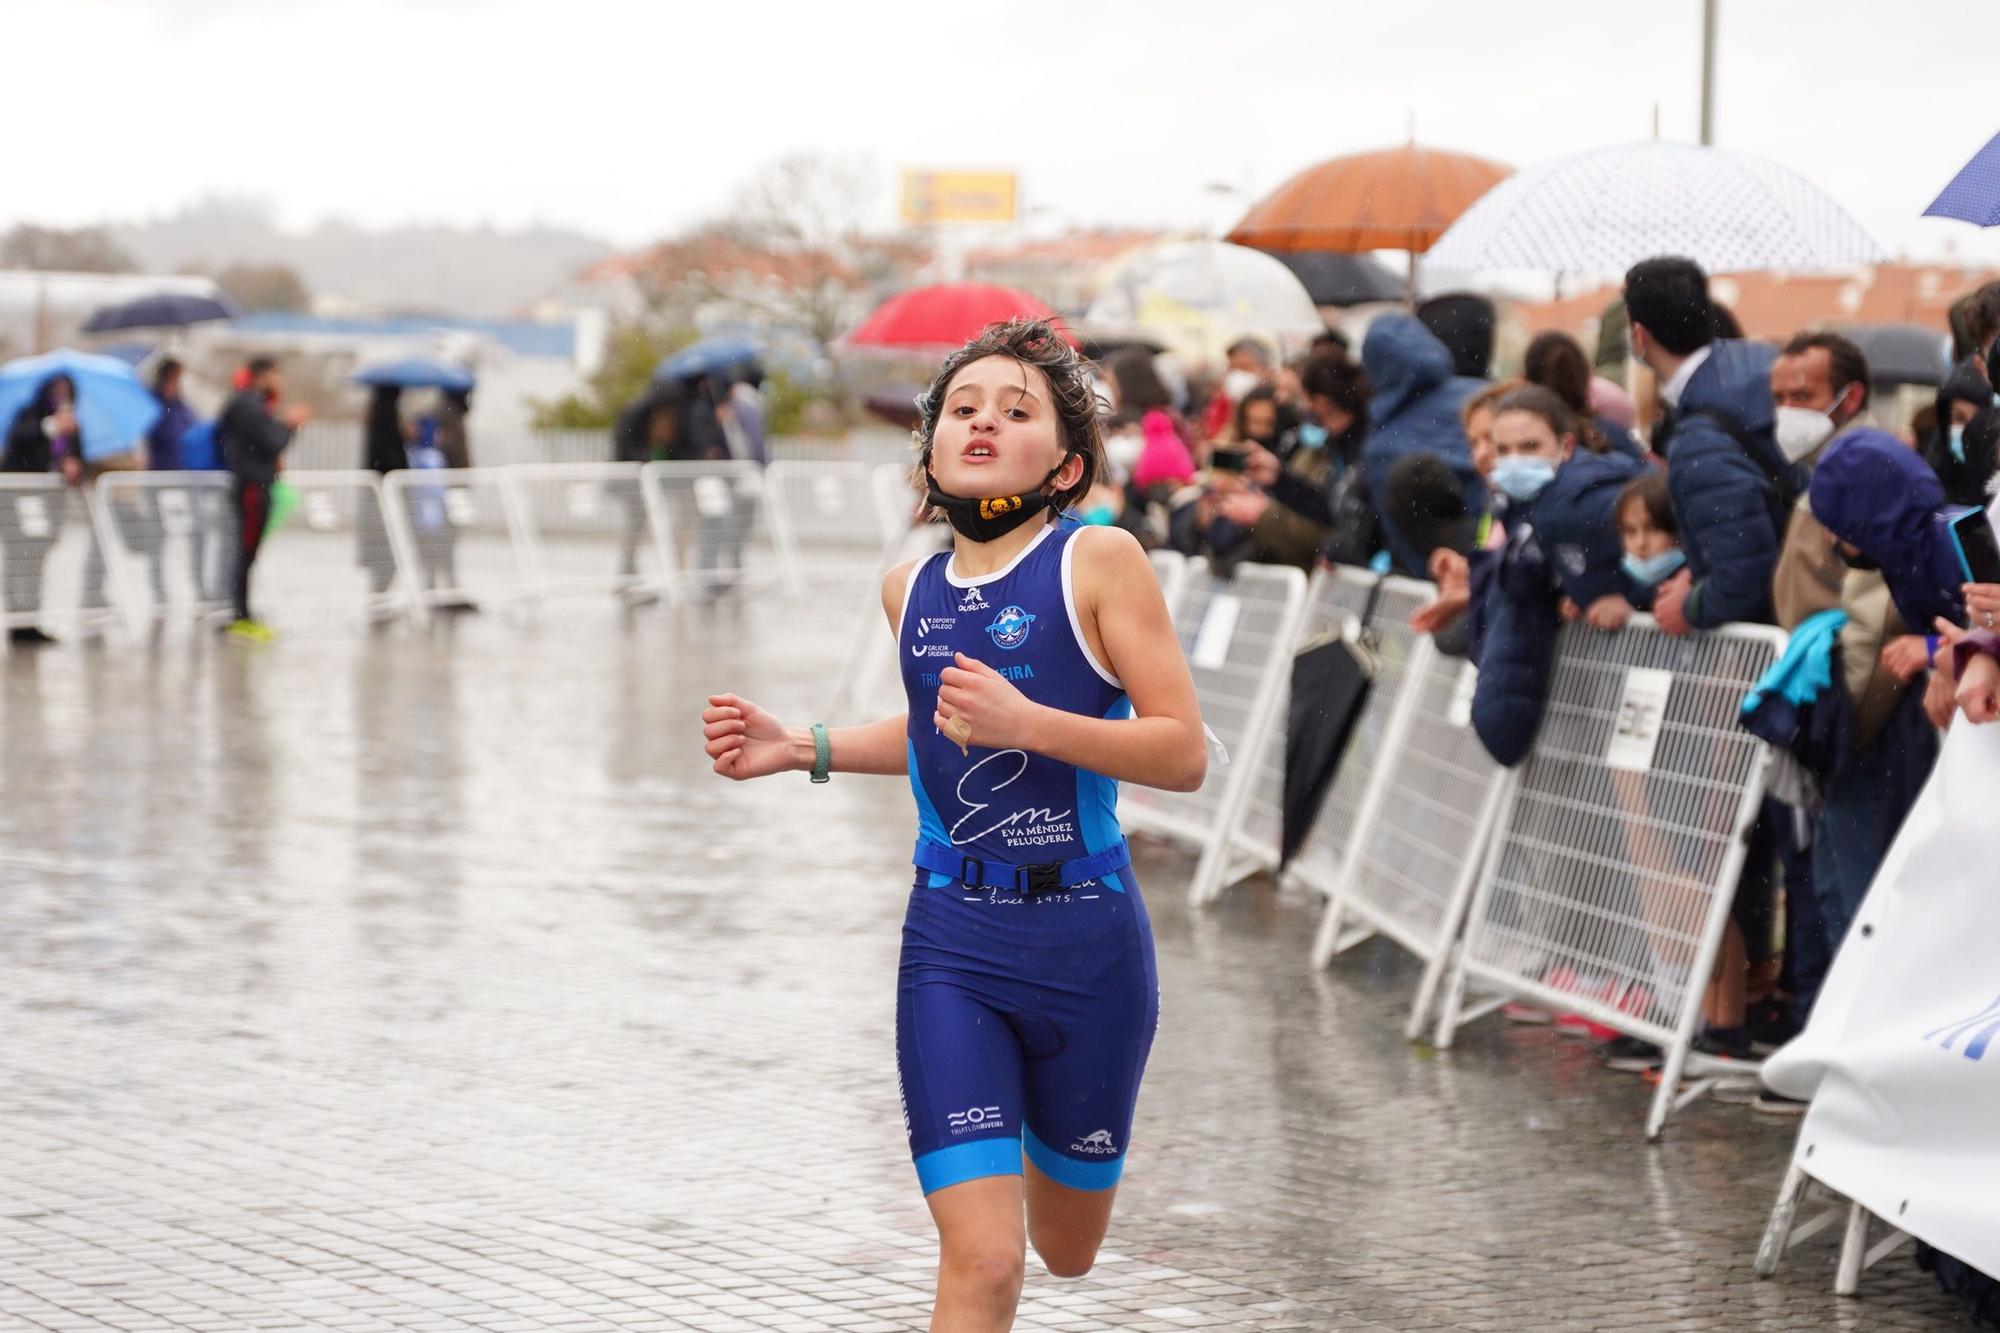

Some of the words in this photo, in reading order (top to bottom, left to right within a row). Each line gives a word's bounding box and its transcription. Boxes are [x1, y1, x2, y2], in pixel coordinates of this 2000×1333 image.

[1001, 828, 1025, 837] EVA
[1026, 822, 1073, 835] MÉNDEZ
[989, 895, 1025, 905] Since
